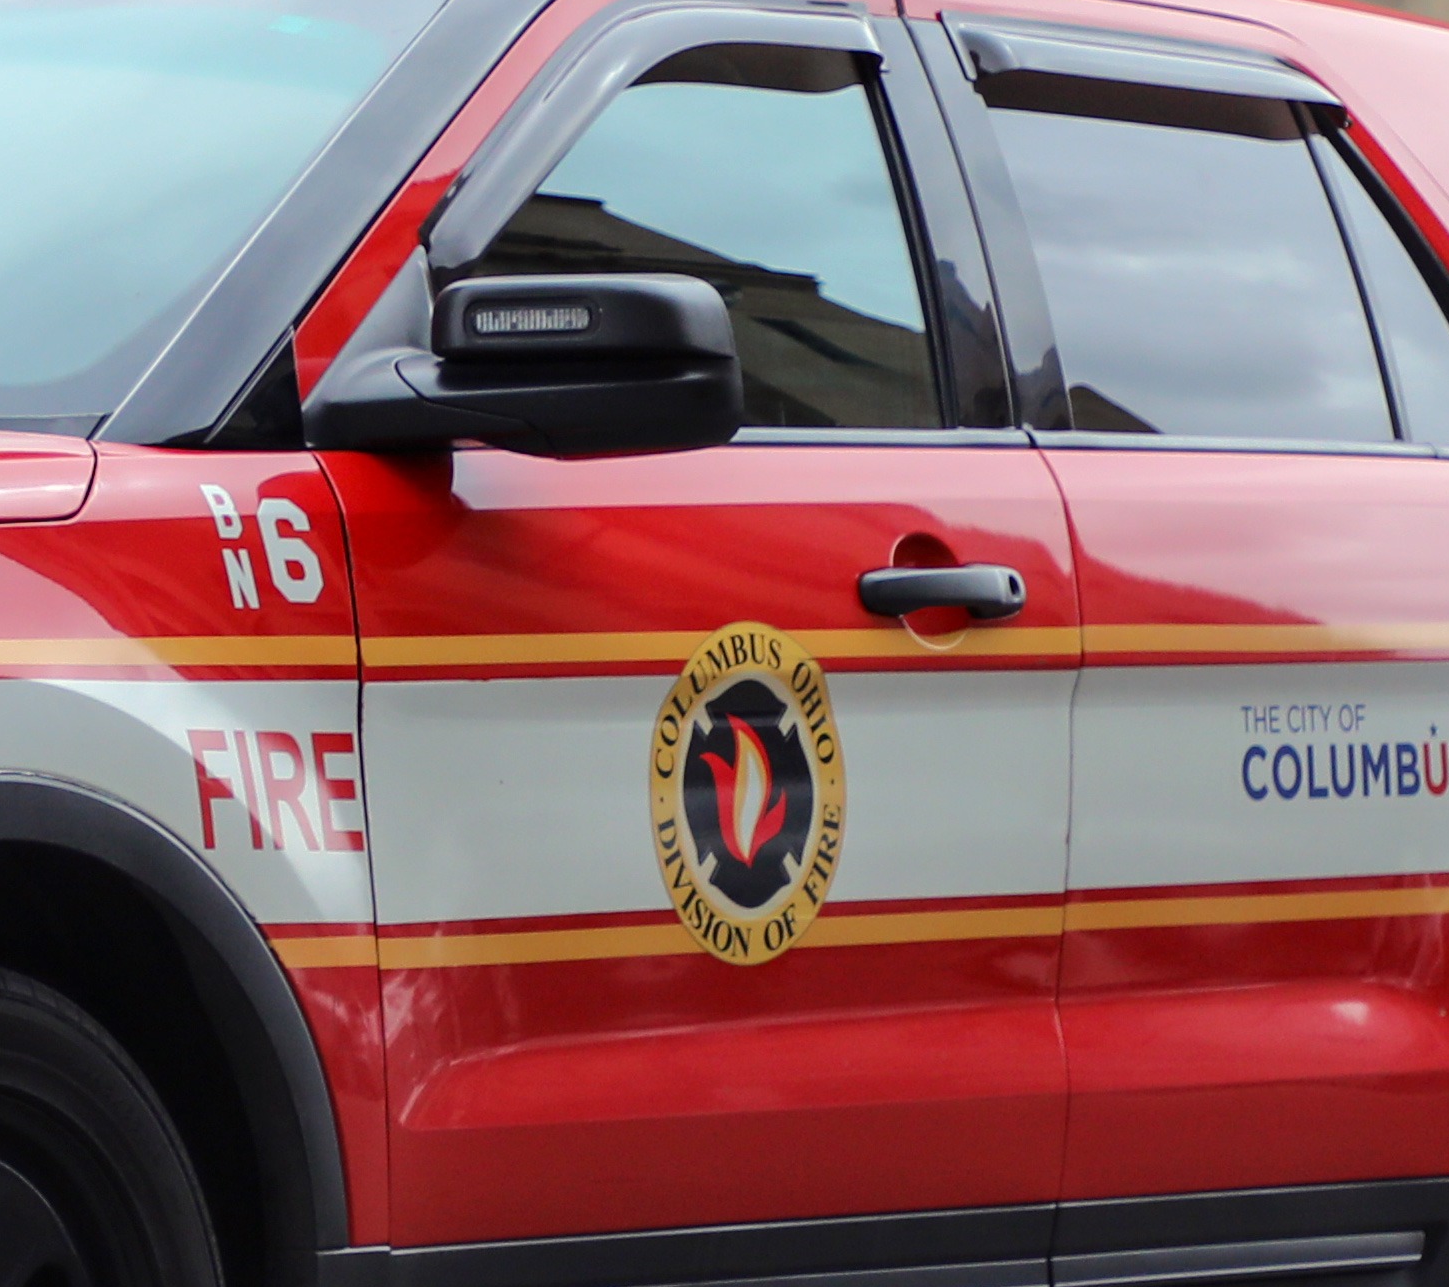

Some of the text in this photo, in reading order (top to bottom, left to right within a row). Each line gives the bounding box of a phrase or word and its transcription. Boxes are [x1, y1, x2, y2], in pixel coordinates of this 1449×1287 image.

[256, 497, 325, 605] 6
[655, 633, 836, 780] COLUMBUS OHIO
[1241, 704, 1366, 733] THE CITY OF
[186, 728, 365, 853] FIRE
[657, 803, 843, 957] DIVISION OF FIRE
